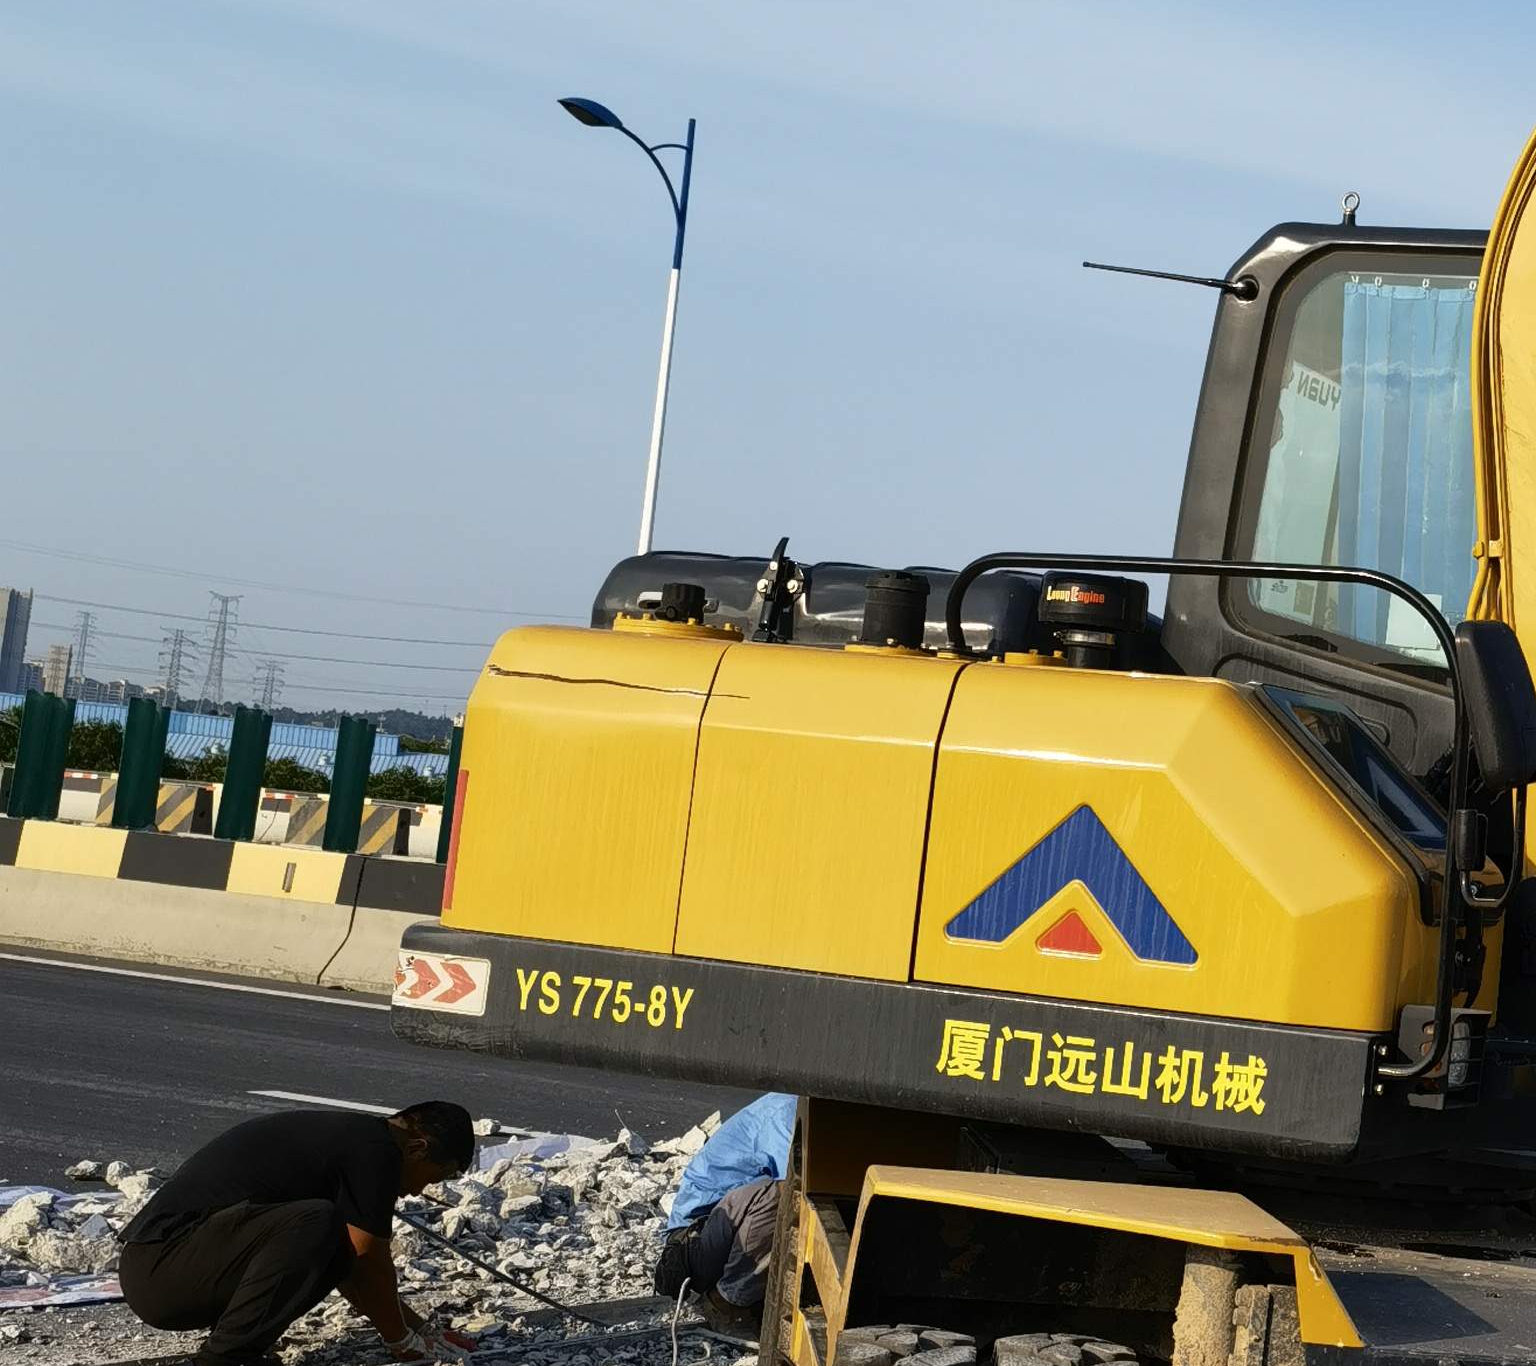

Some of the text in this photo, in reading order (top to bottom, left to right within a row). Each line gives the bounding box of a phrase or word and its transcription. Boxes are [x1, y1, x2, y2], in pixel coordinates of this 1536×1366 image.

[516, 968, 695, 1029] YS 775-8Y
[936, 1019, 1268, 1115] 厦门远山机械
